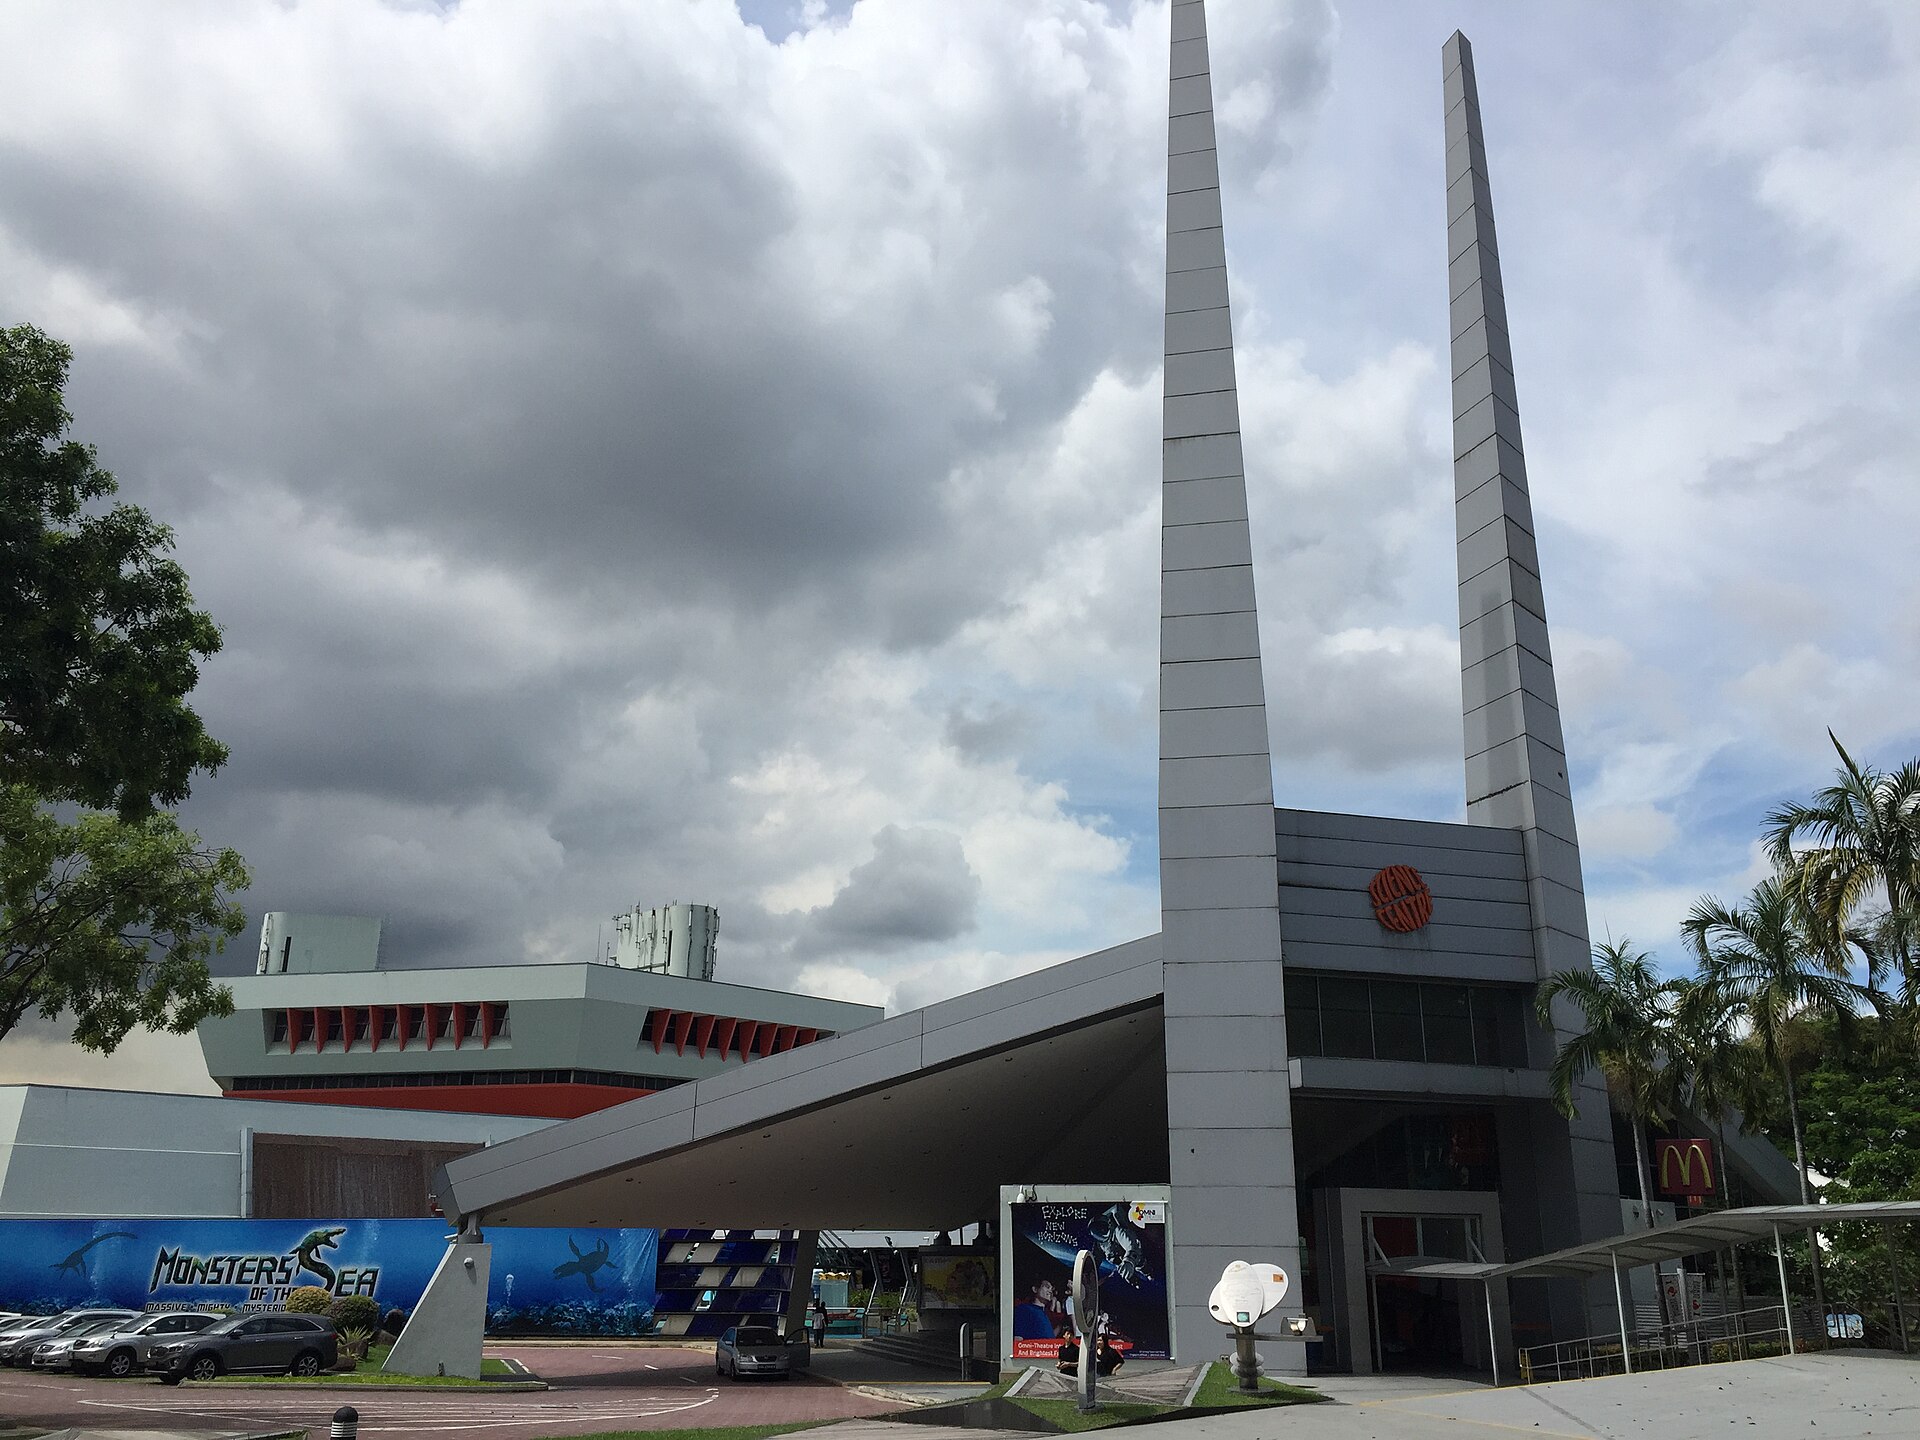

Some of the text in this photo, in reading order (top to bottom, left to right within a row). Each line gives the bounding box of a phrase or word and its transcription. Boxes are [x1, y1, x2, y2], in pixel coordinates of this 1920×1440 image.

[1041, 1205, 1088, 1220] EXPLORE
[1045, 1221, 1065, 1231] NEW
[1037, 1230, 1079, 1247] HORIZONS
[149, 1246, 297, 1294] MONSTERS
[249, 1286, 269, 1301] OF
[145, 1303, 188, 1313] MASSIVE
[242, 1303, 287, 1313] MYSTERIO
